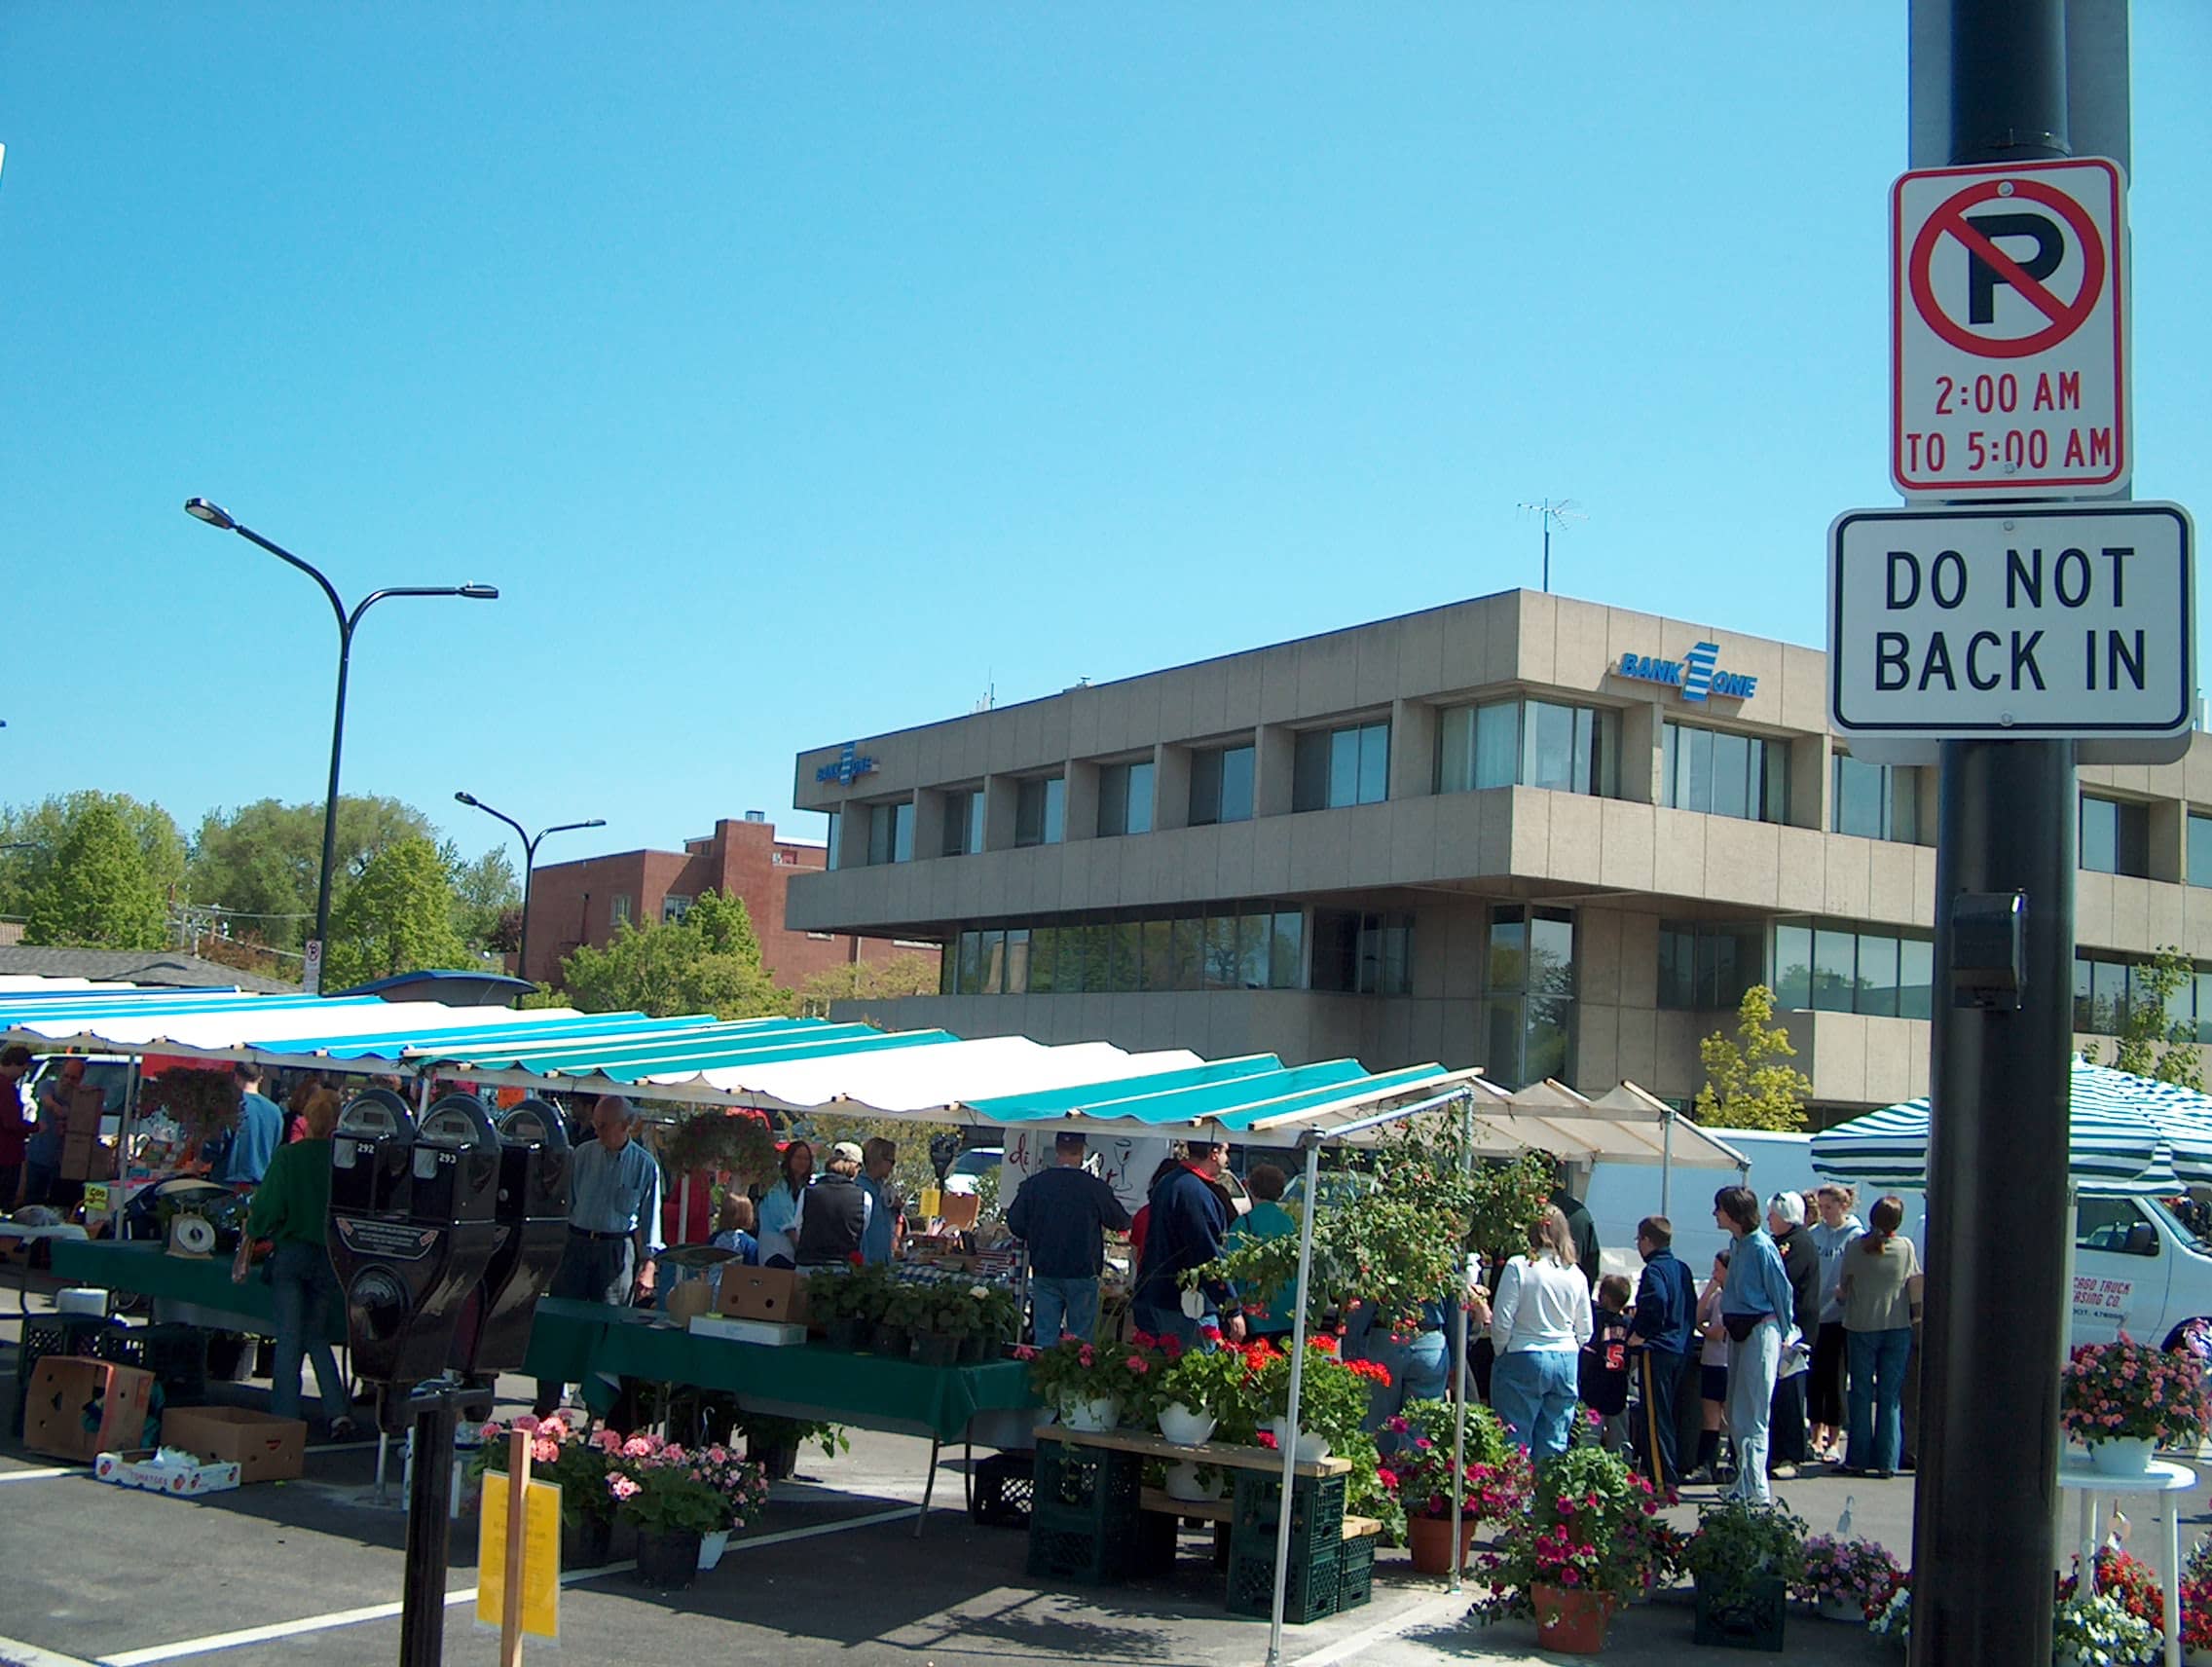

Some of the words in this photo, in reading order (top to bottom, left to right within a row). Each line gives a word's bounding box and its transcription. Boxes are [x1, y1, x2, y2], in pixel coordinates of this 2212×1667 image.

[1936, 373, 2017, 415] 2:00
[2033, 371, 2080, 411] AM
[1906, 432, 1945, 472] TO
[1968, 428, 2047, 471] 5:00
[2063, 426, 2112, 467] AM
[1886, 549, 1968, 610] DO
[2006, 547, 2135, 609] NOT
[1621, 652, 1683, 685] BANK
[1713, 671, 1758, 697] ONE
[1875, 630, 2046, 691] BACK
[2086, 629, 2146, 690] IN
[357, 1142, 375, 1154] 292
[438, 1152, 457, 1164] 293
[2073, 1290, 2104, 1306] ASING
[2100, 1280, 2131, 1294] TRUCK
[1605, 1344, 1625, 1371] 5
